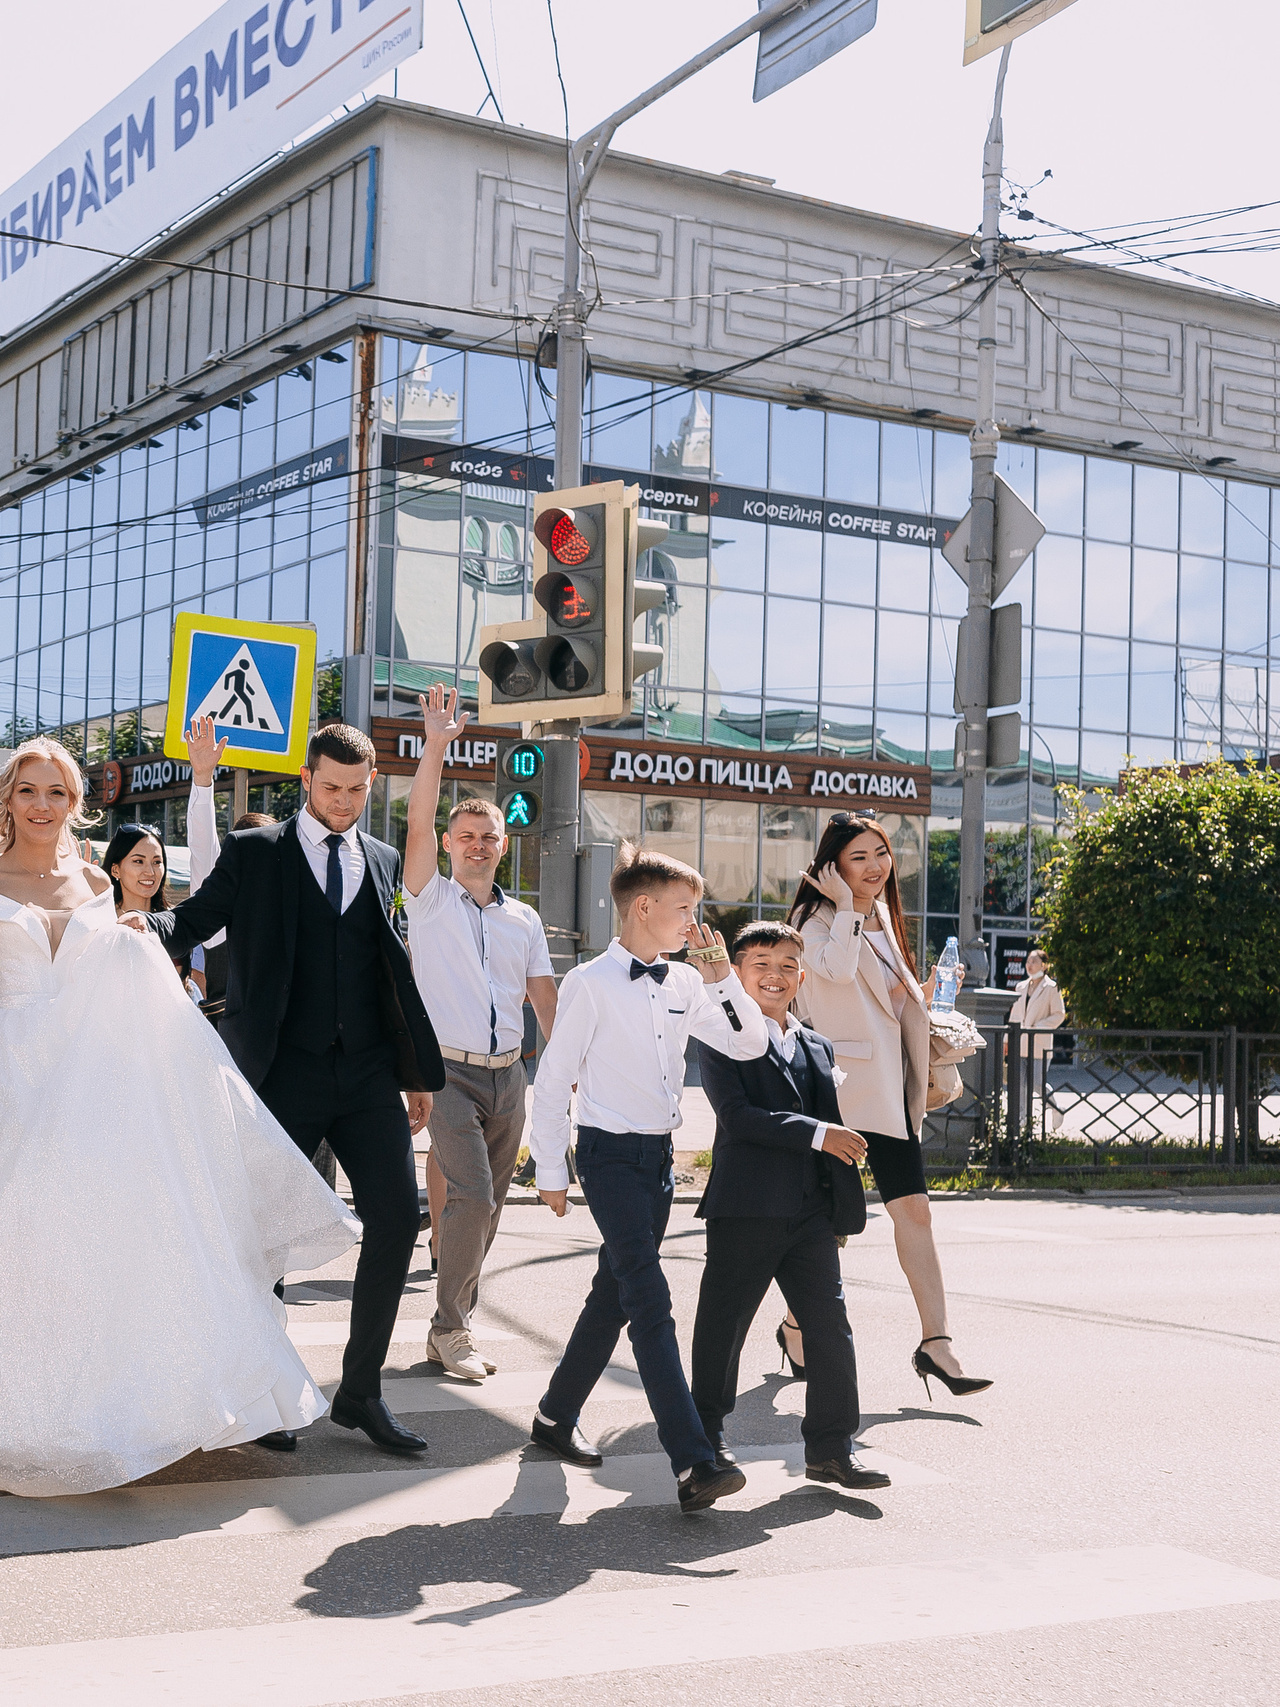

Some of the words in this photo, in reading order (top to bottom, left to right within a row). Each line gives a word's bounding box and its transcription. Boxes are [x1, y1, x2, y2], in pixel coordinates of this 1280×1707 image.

[173, 0, 375, 152] ВМЕС
[256, 469, 300, 500] COFFEE
[302, 456, 333, 481] STAR
[742, 499, 822, 525] КОФЕЙНЯ
[827, 512, 892, 536] COFFEE
[896, 522, 937, 542] STAR
[130, 760, 173, 793] ДОДО
[514, 751, 535, 776] 10
[610, 750, 695, 786] ДОДО
[699, 758, 793, 795] ПИЦЦА
[810, 769, 918, 800] ДОСТАВКА
